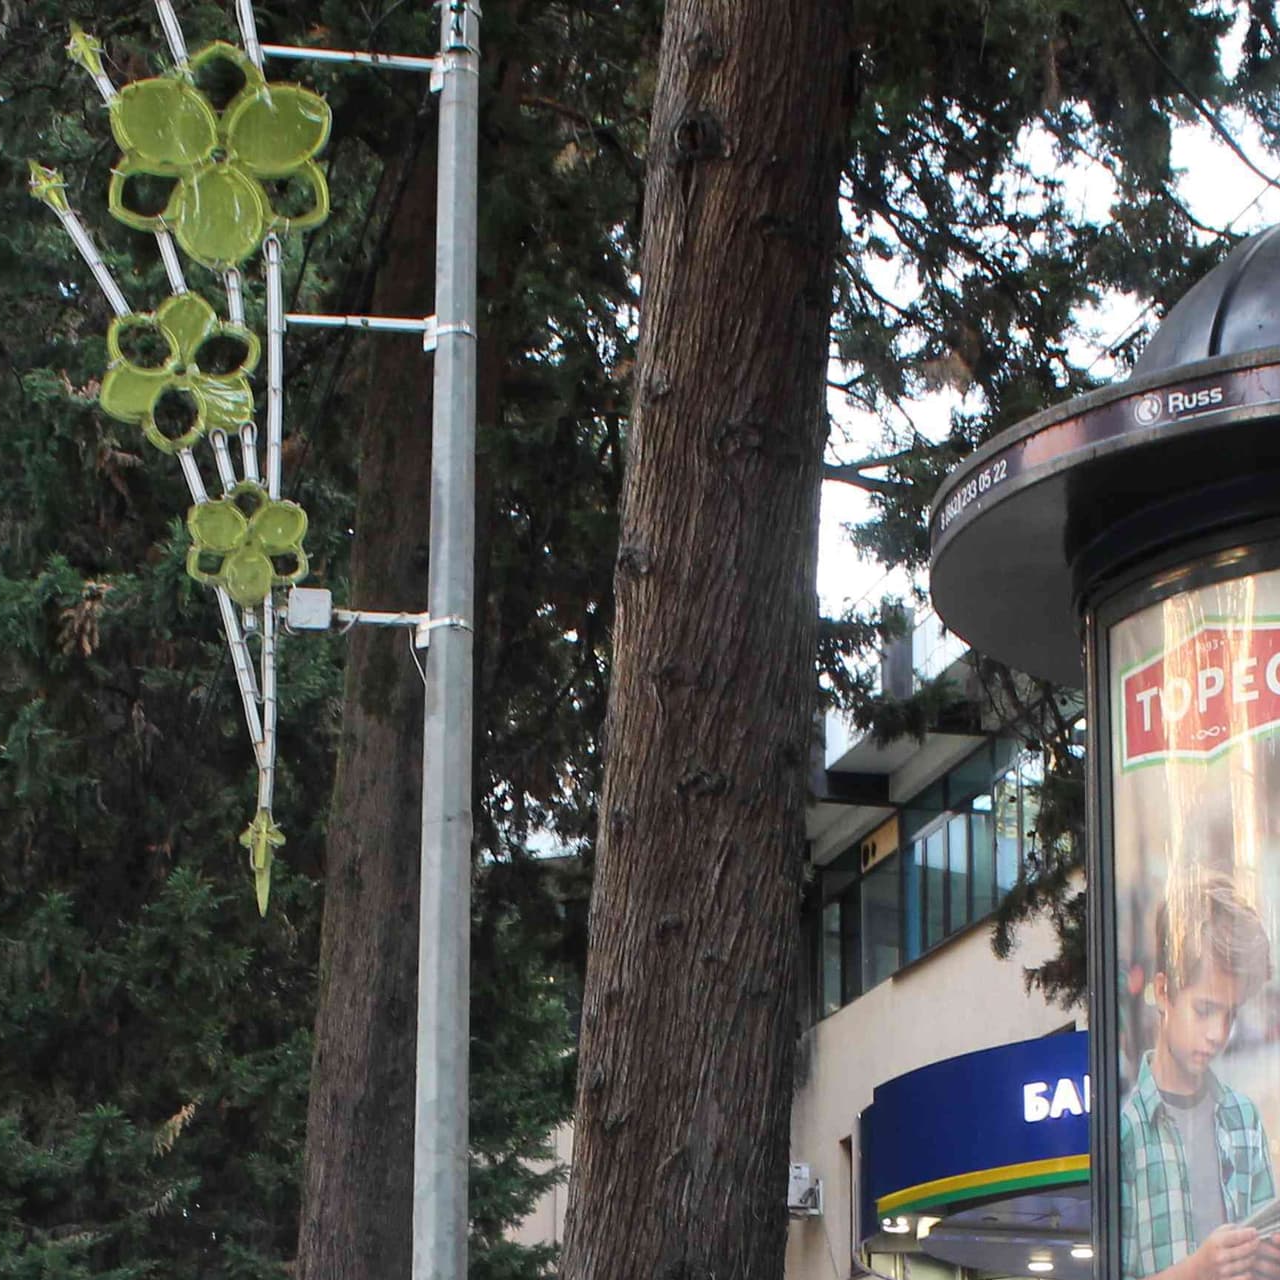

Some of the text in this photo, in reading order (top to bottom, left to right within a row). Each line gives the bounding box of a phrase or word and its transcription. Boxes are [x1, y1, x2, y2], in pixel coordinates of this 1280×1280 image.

[961, 480, 978, 507] 233
[978, 469, 992, 493] 05
[992, 460, 1008, 483] 22
